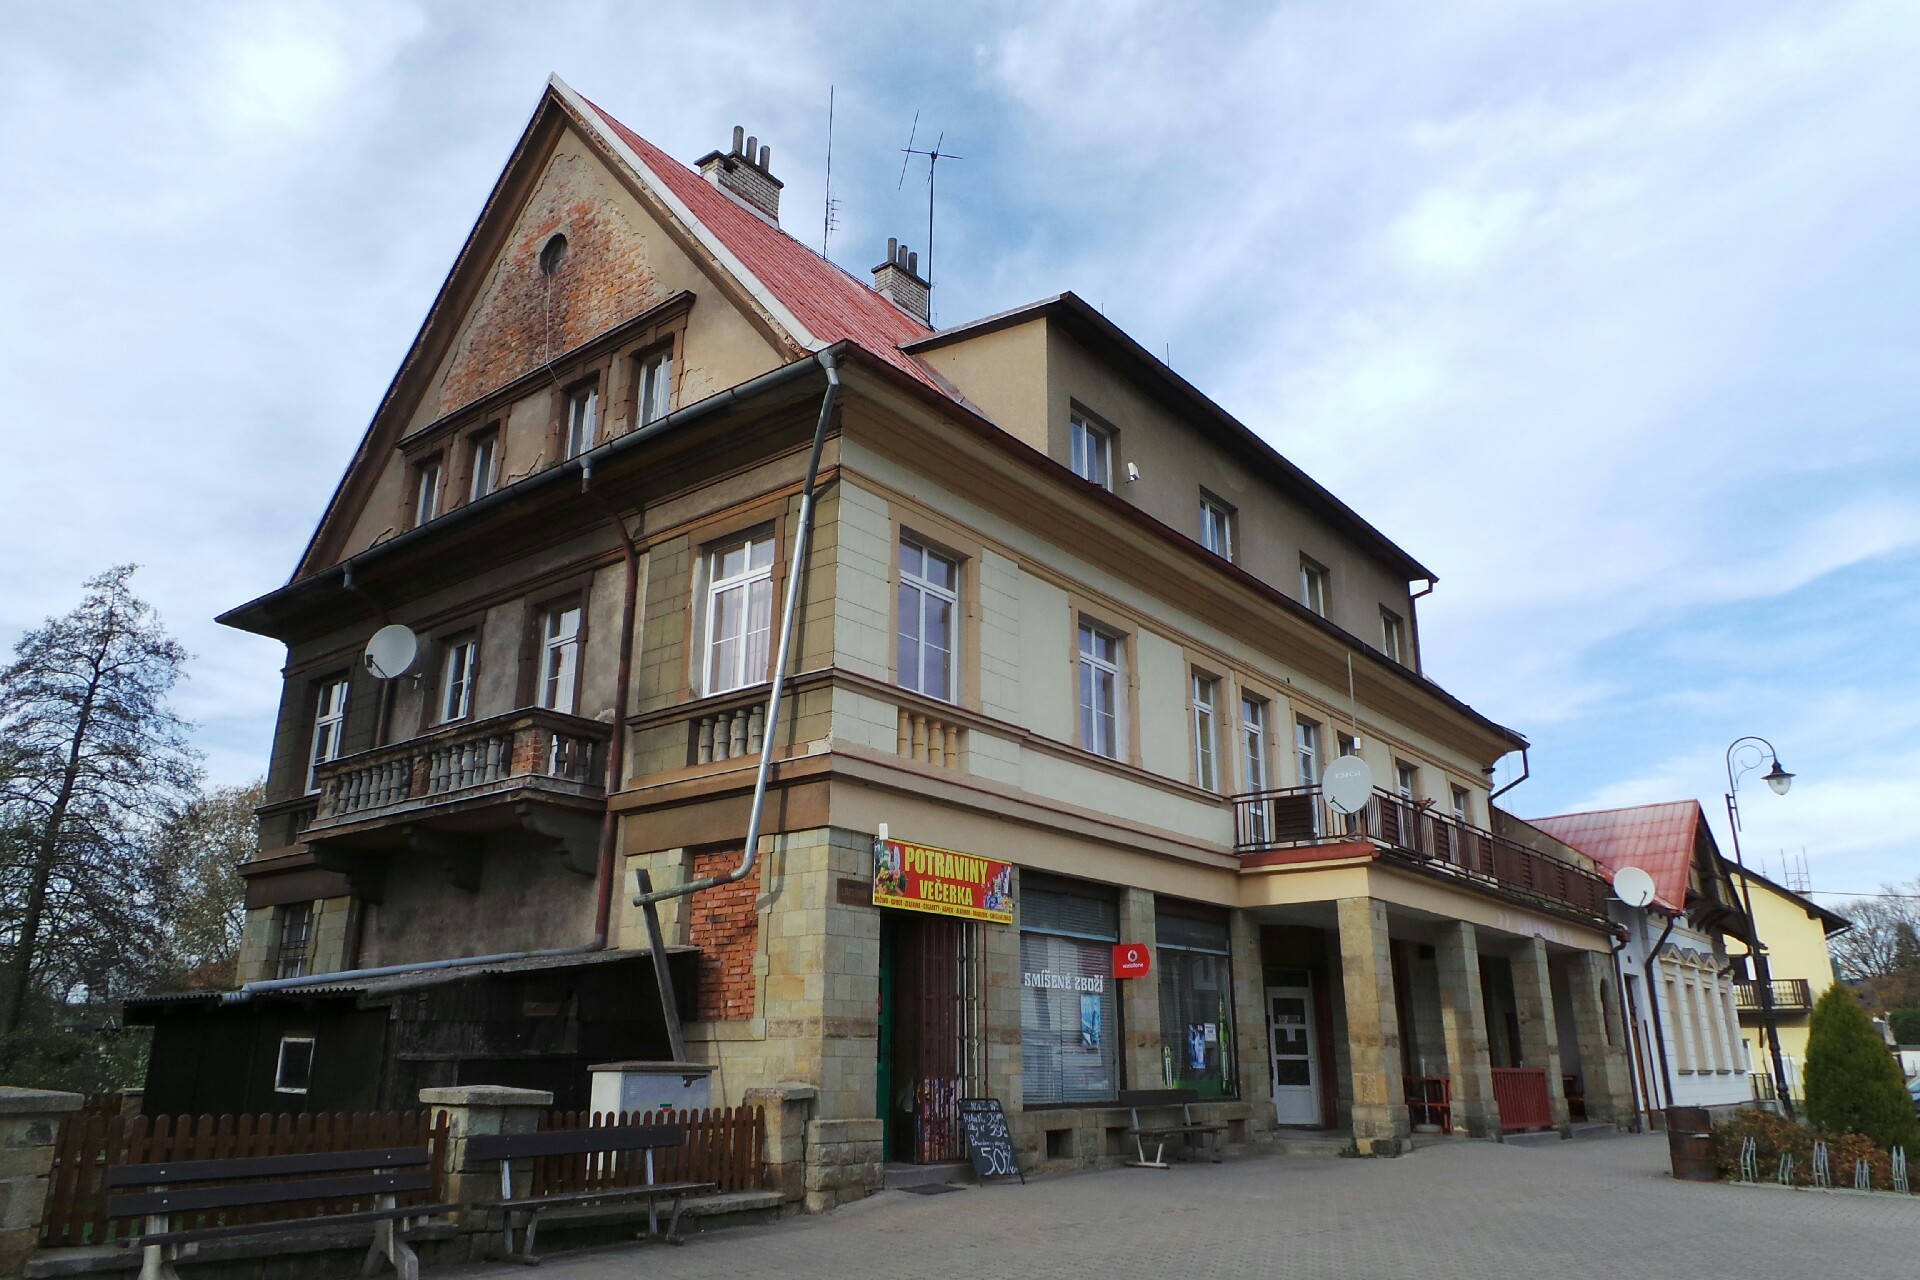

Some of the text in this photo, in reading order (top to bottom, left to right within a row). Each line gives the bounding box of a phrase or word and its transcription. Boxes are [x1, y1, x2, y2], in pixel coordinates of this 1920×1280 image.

[1335, 770, 1361, 779] DIGI
[905, 847, 988, 884] POTRAVINY
[920, 880, 973, 905] VEČERKA
[1024, 969, 1104, 993] SMÍŠENÉ ZBOŽÍ
